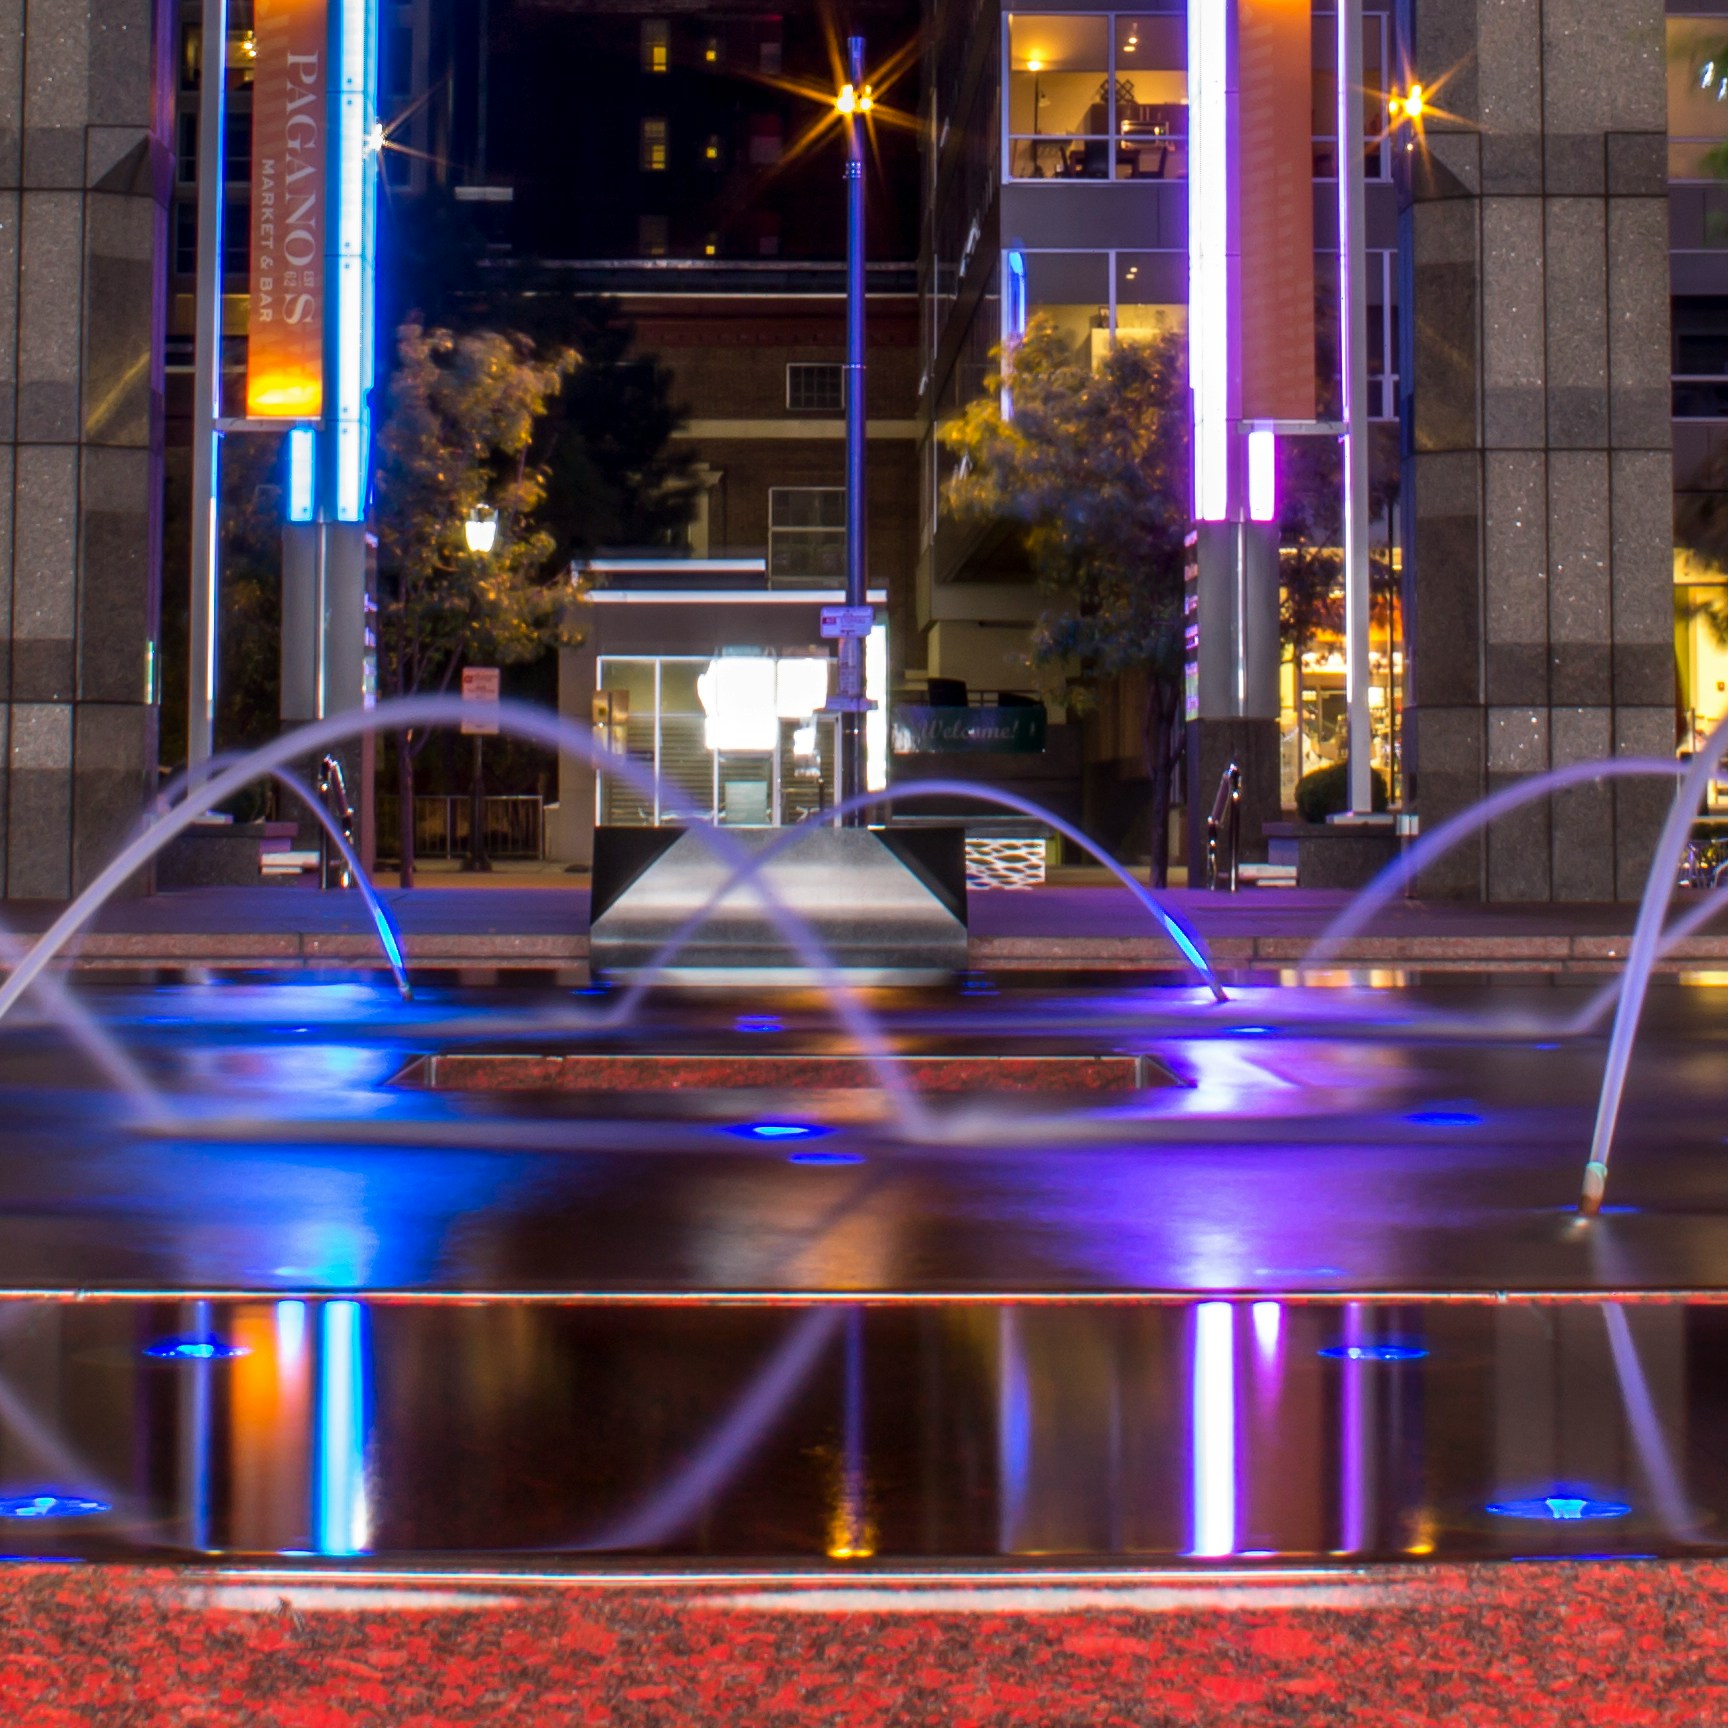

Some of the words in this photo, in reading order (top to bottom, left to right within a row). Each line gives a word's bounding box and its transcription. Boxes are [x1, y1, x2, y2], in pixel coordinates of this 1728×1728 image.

[261, 159, 275, 249] MARKET
[260, 256, 273, 270] &
[259, 277, 273, 322] BAR
